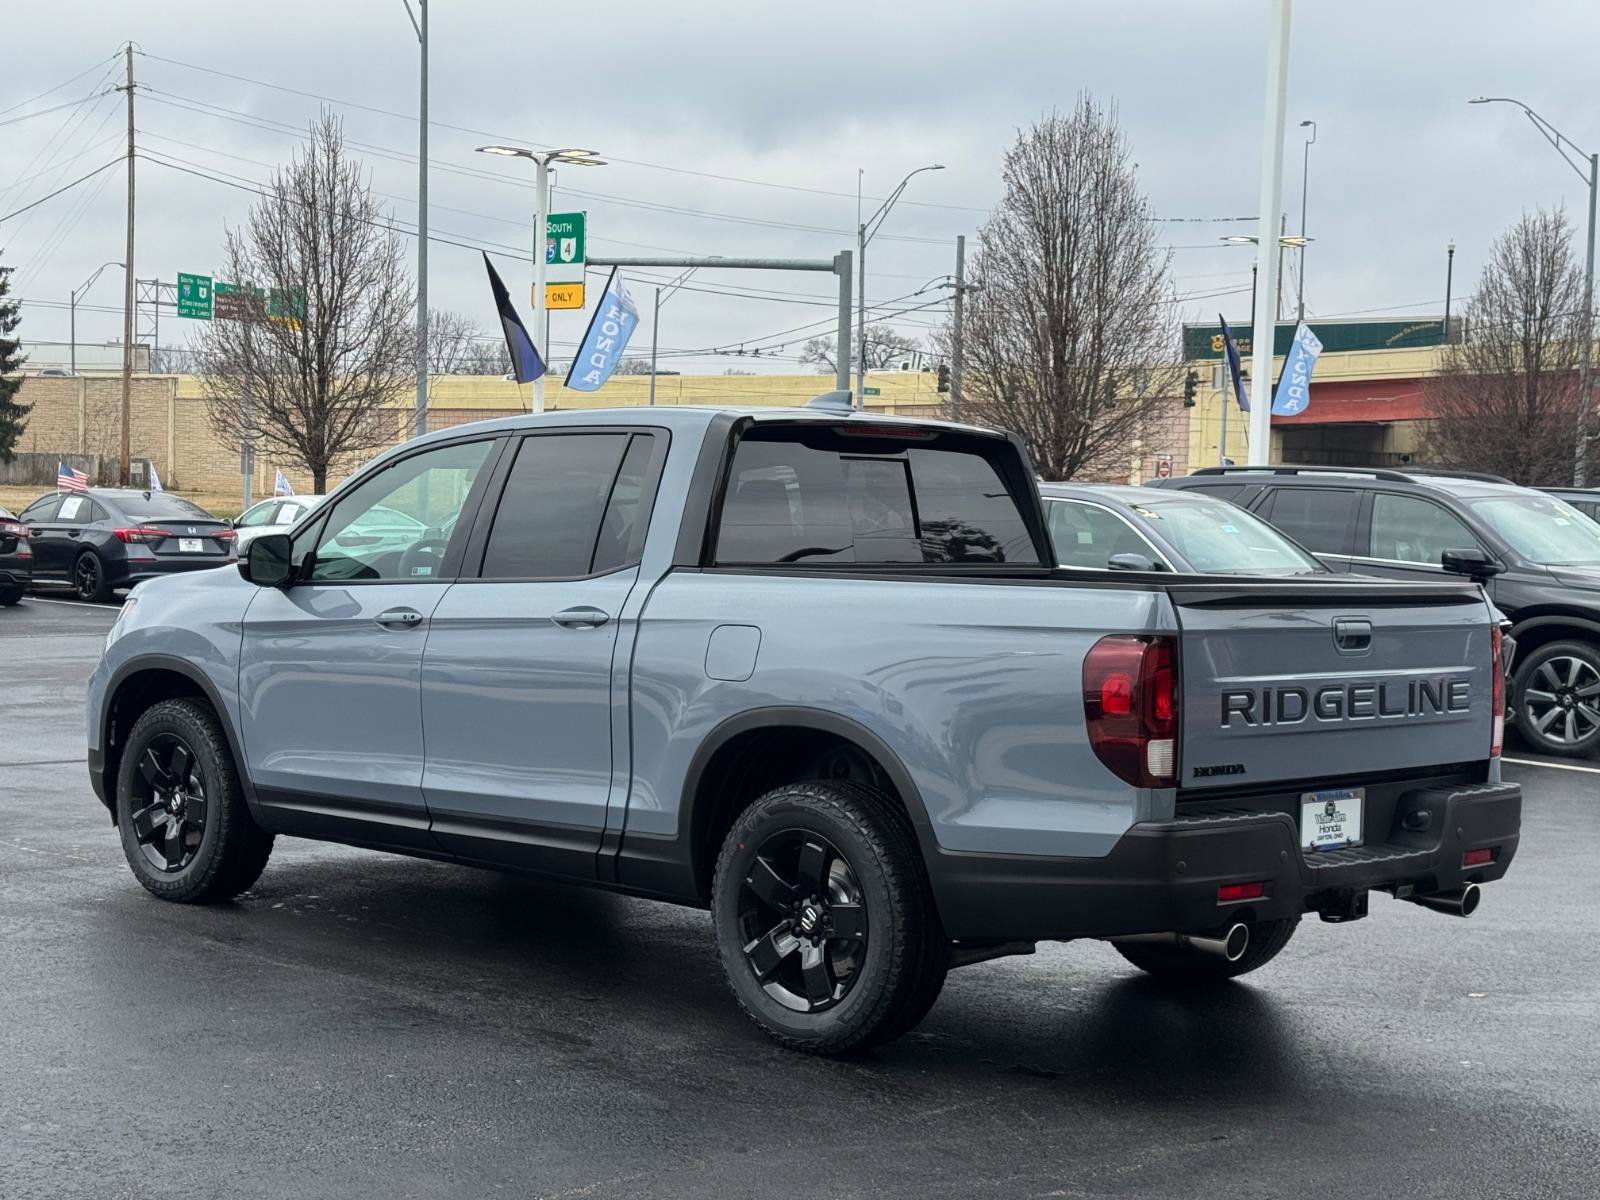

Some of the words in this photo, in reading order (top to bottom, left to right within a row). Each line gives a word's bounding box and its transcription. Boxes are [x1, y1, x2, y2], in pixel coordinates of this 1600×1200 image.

[546, 221, 573, 234] SOUTH
[564, 242, 571, 256] 4
[551, 292, 574, 303] ONLY
[1220, 678, 1472, 729] RIDGELINE
[1192, 763, 1247, 778] HONDA
[1319, 823, 1342, 834] Honda
